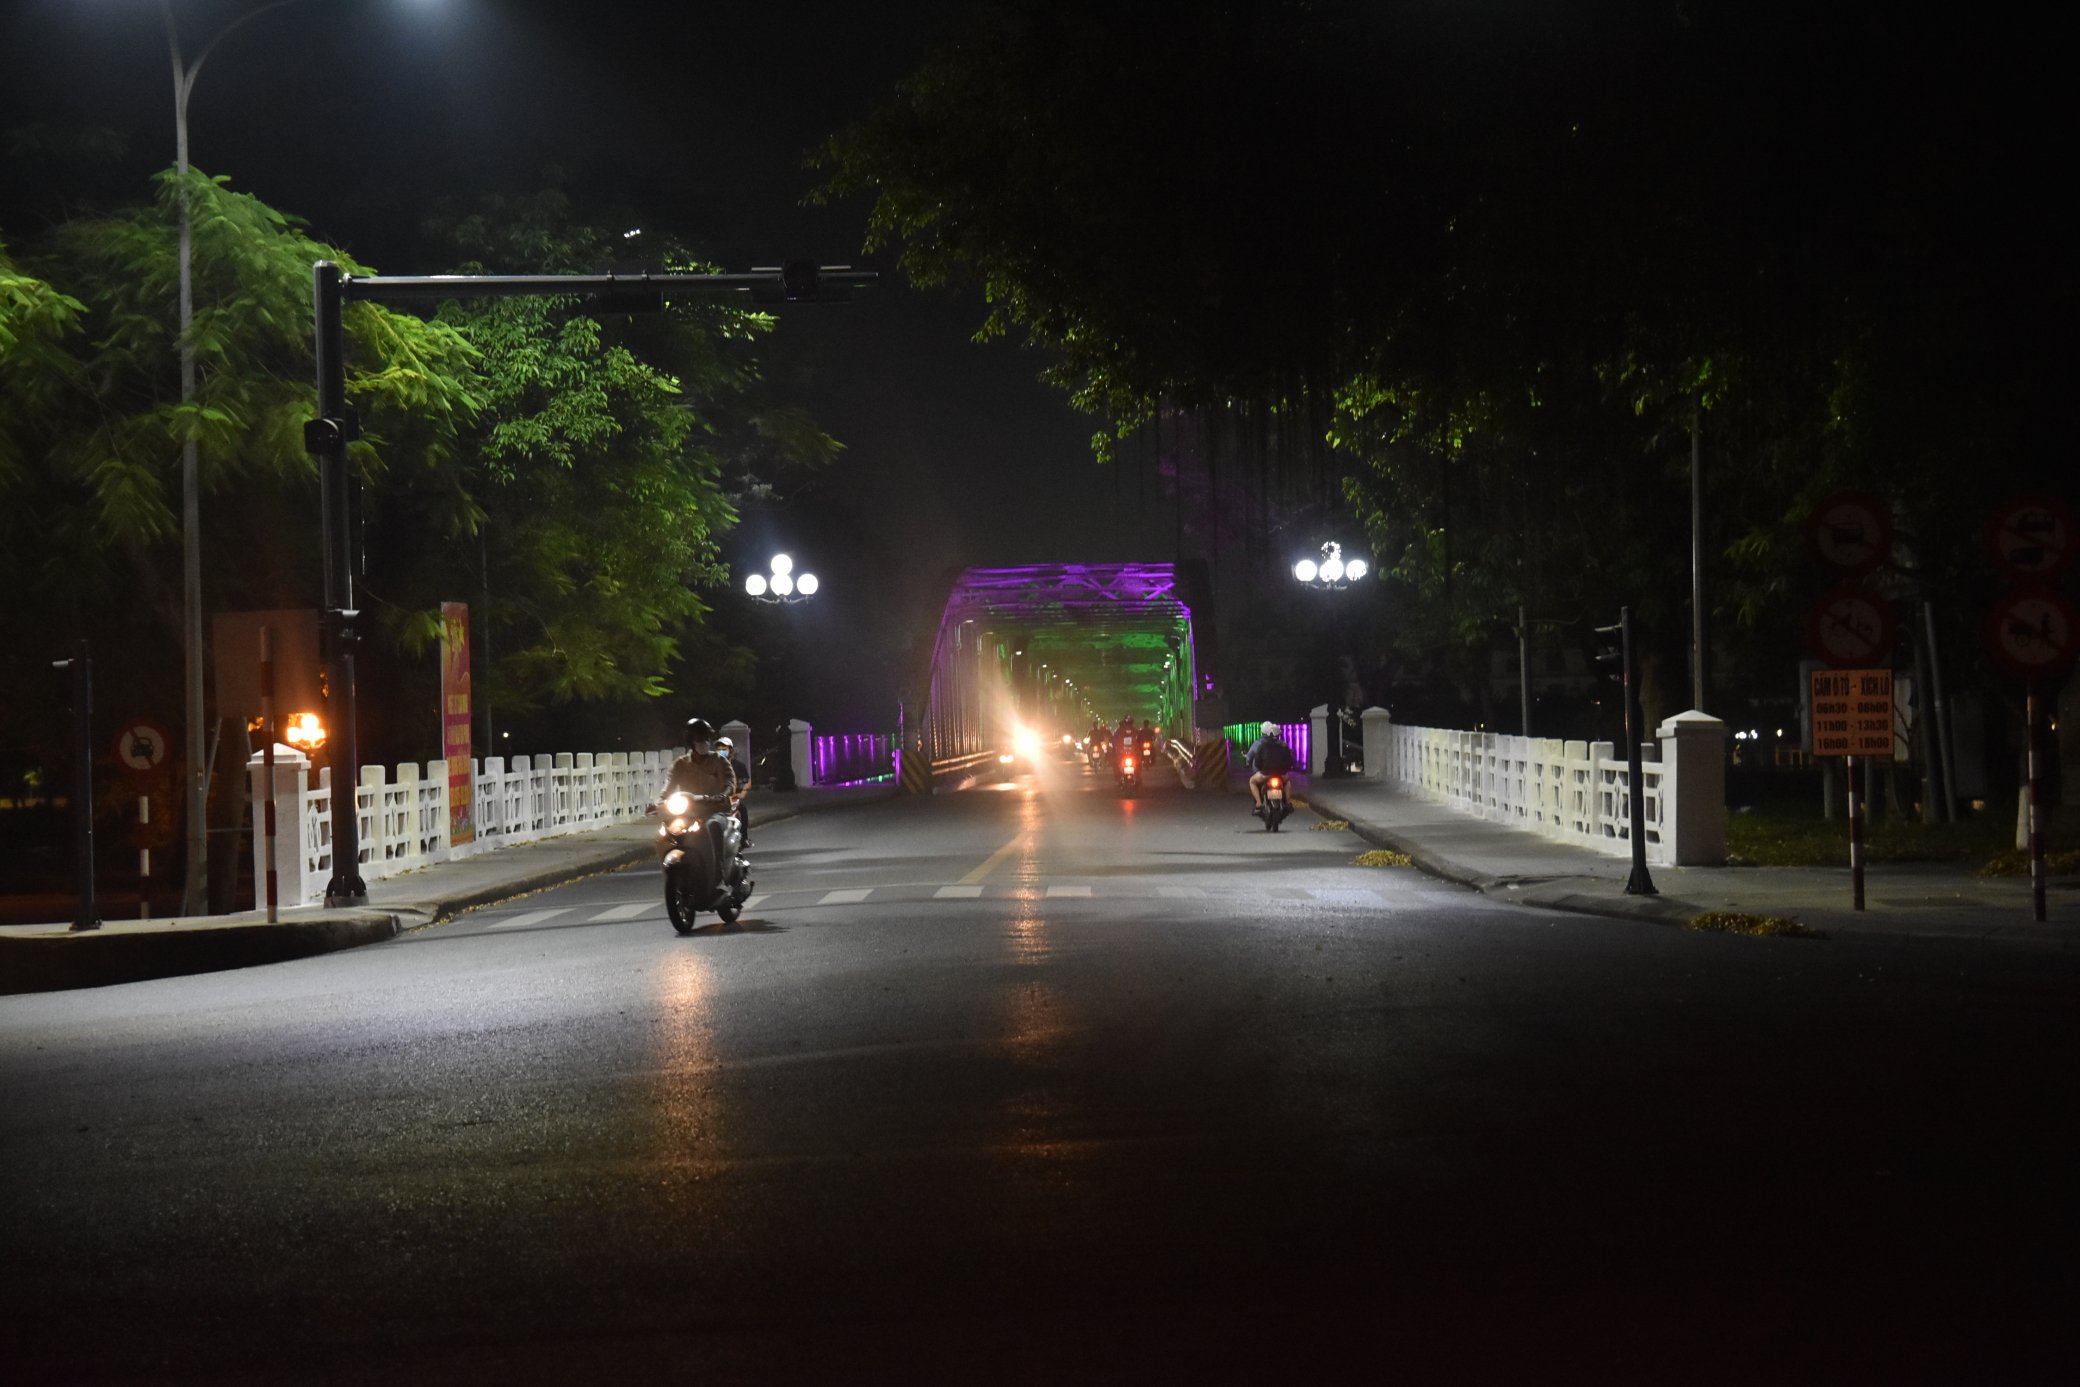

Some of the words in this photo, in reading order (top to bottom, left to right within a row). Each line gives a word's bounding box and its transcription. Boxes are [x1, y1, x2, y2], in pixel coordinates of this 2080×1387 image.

[1816, 702, 1847, 714] 06h30
[1816, 719, 1847, 731] 11h00
[1857, 719, 1888, 731] 13h30
[1818, 737, 1848, 749] 16h00
